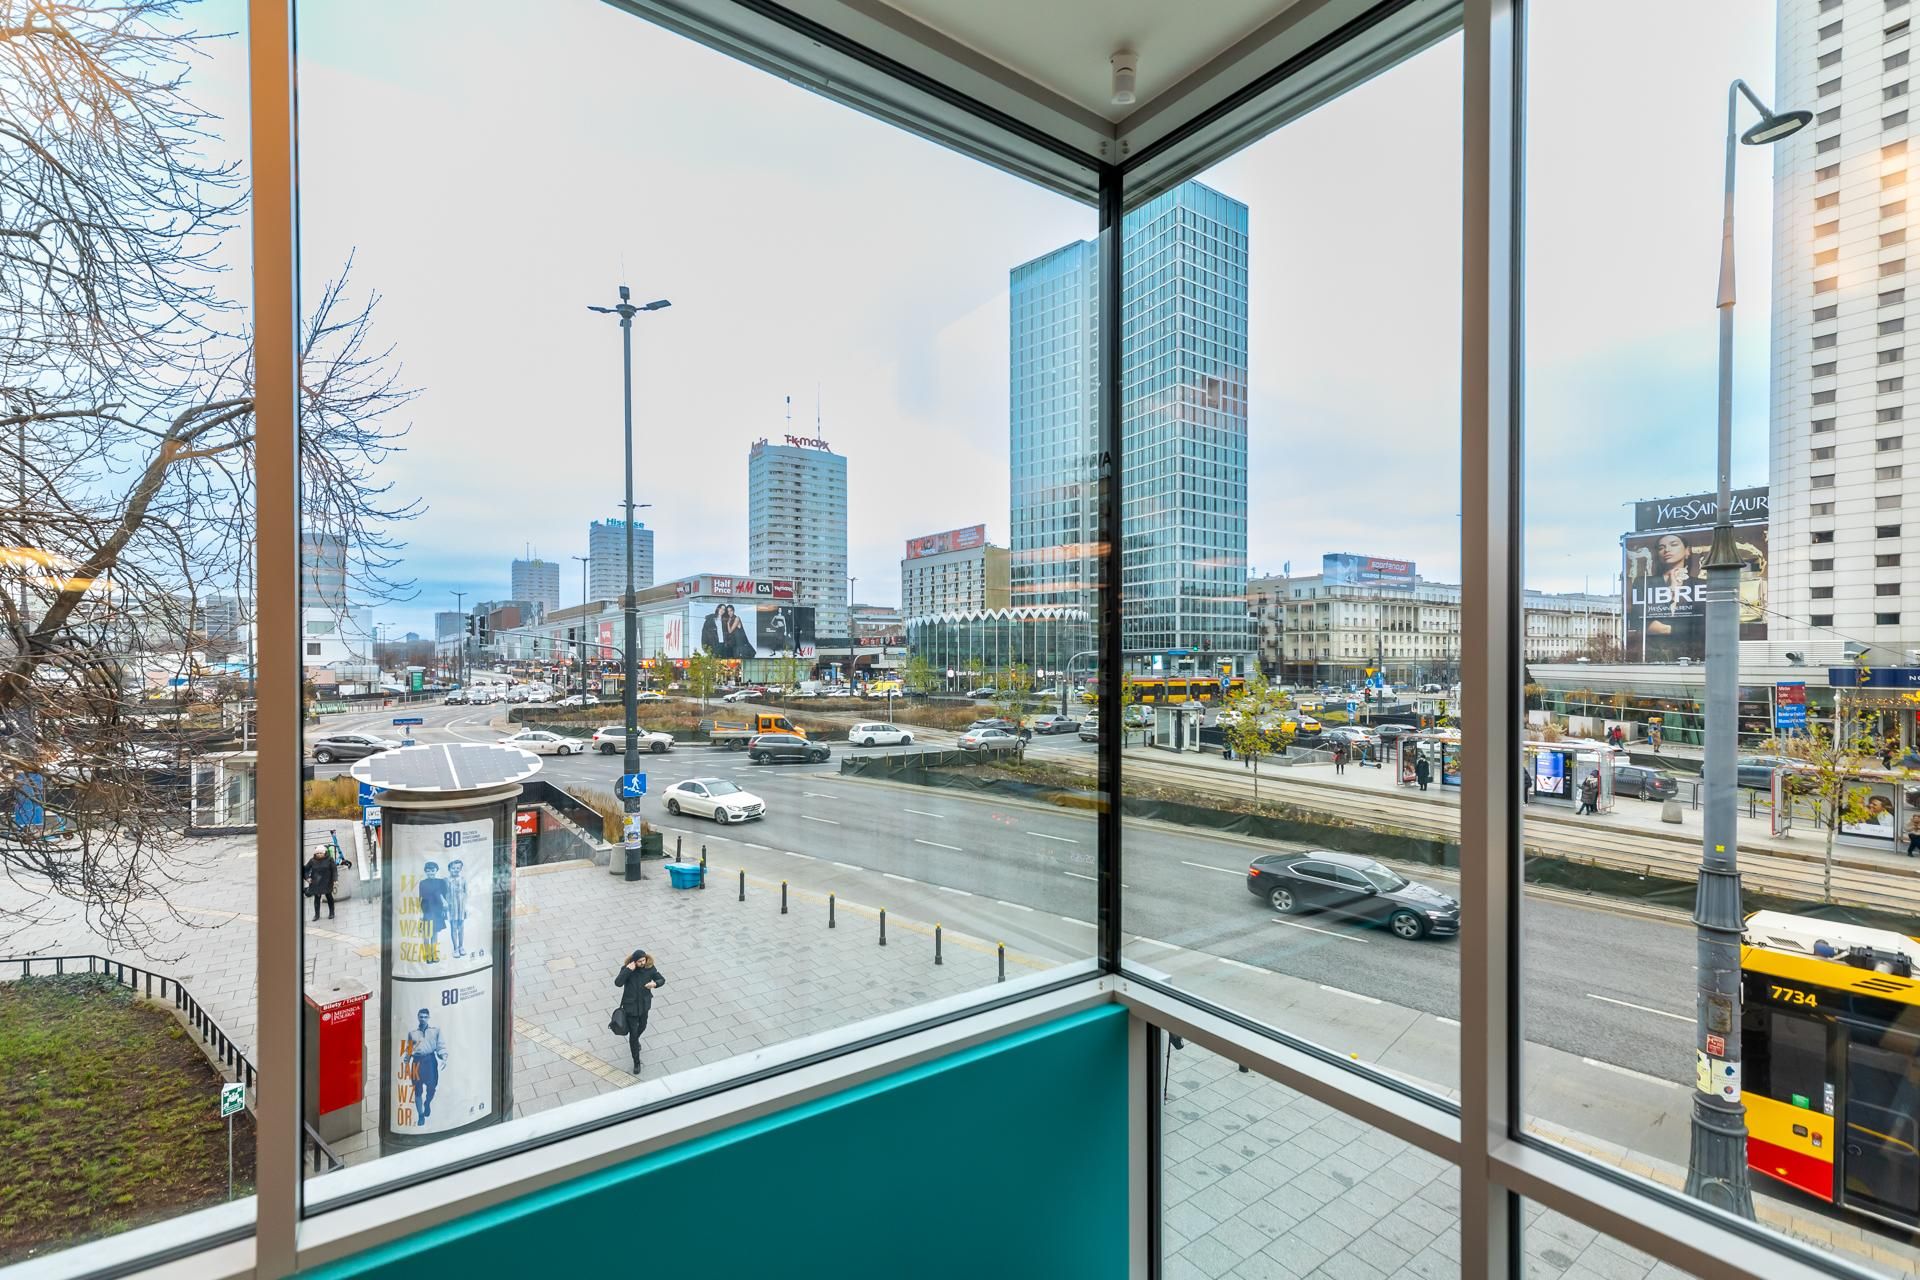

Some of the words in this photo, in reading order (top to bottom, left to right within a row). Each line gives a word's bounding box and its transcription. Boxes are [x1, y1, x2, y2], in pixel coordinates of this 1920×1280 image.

[1657, 503, 1690, 524] YVES
[1730, 495, 1769, 516] LAUR
[606, 517, 645, 529] Hisese
[714, 579, 731, 588] Half
[714, 586, 732, 594] Price
[1632, 584, 1708, 605] LIBRE
[444, 830, 461, 848] 80
[442, 988, 459, 1006] 80
[1771, 985, 1818, 1008] 7734
